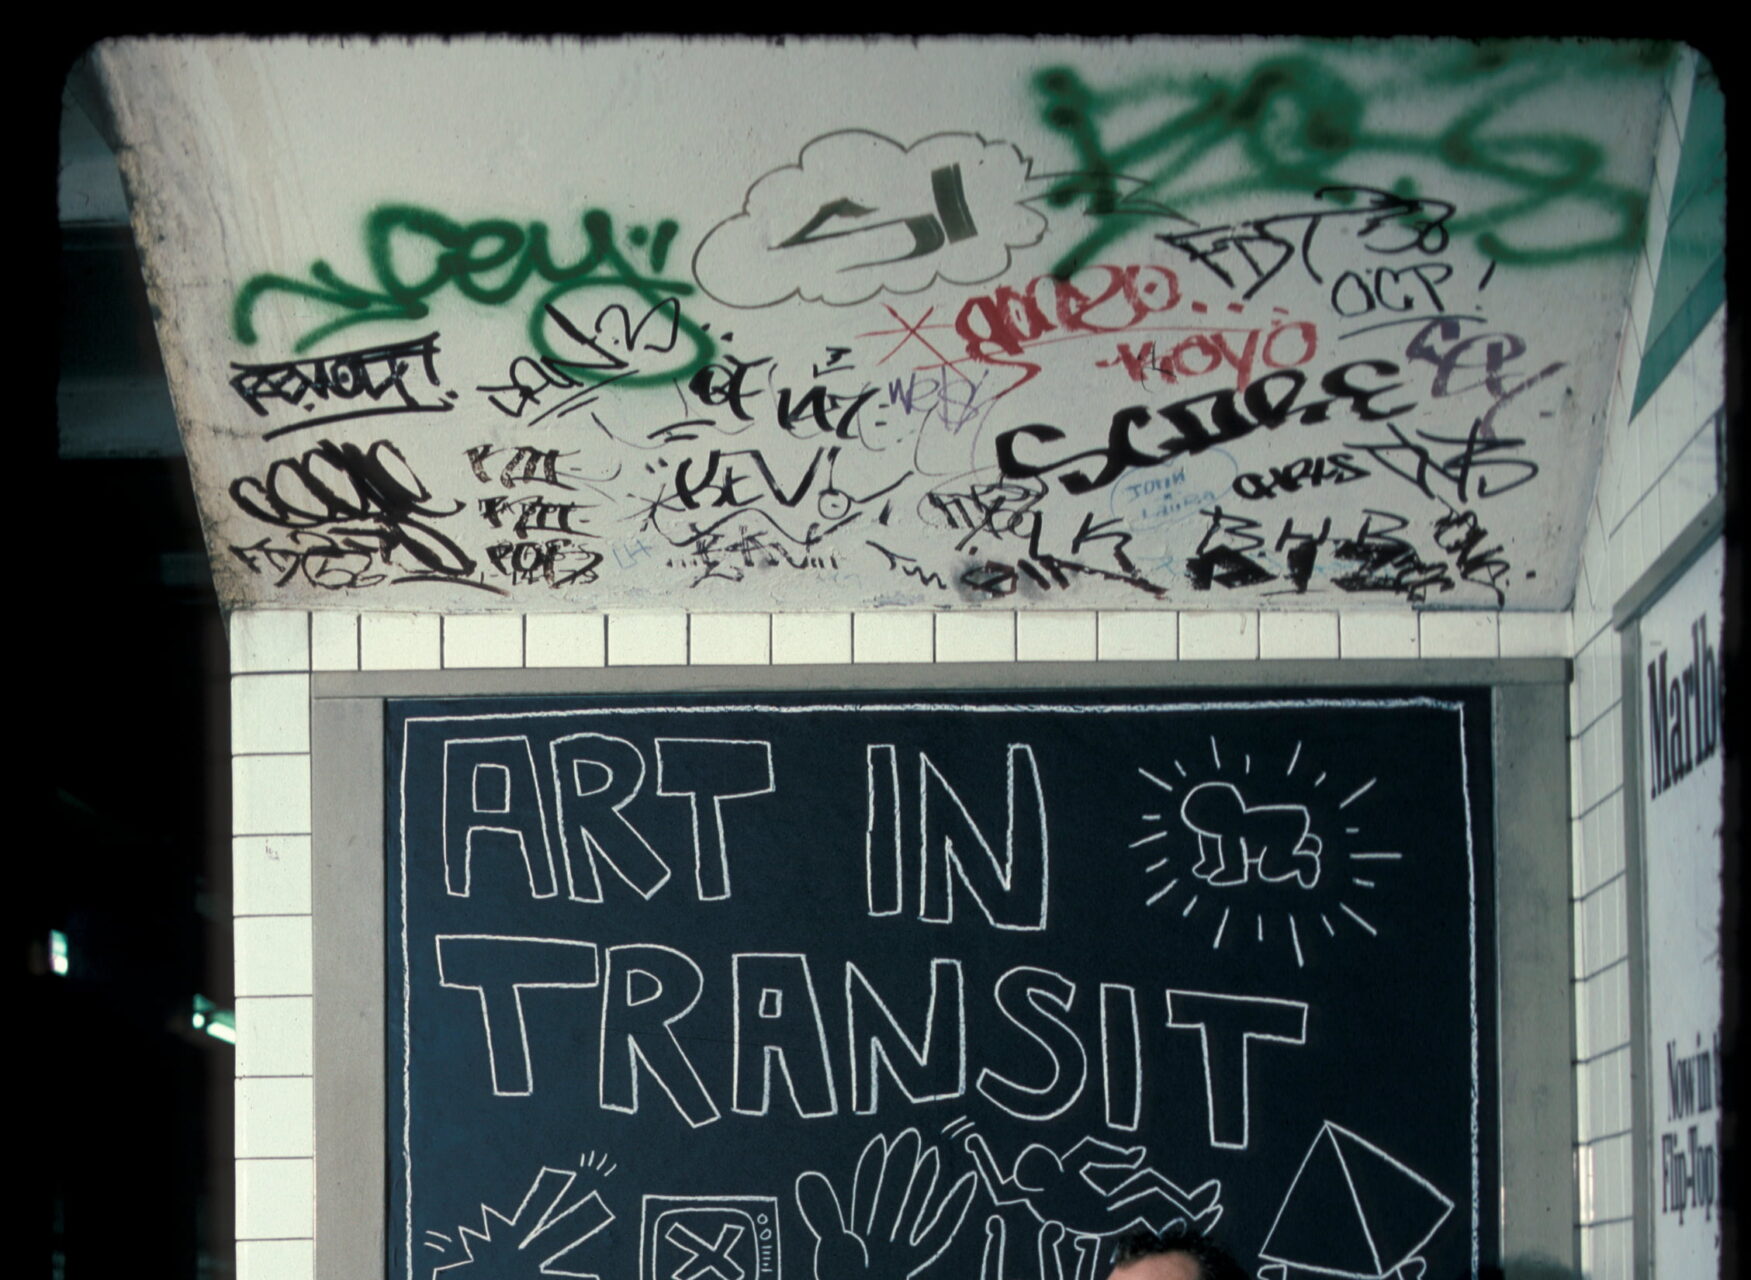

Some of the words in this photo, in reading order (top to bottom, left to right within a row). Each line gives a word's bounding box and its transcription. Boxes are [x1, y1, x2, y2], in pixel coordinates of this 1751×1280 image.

[442, 733, 775, 902] ART
[867, 743, 1049, 930] IN
[435, 935, 1308, 1150] TRANSIT
